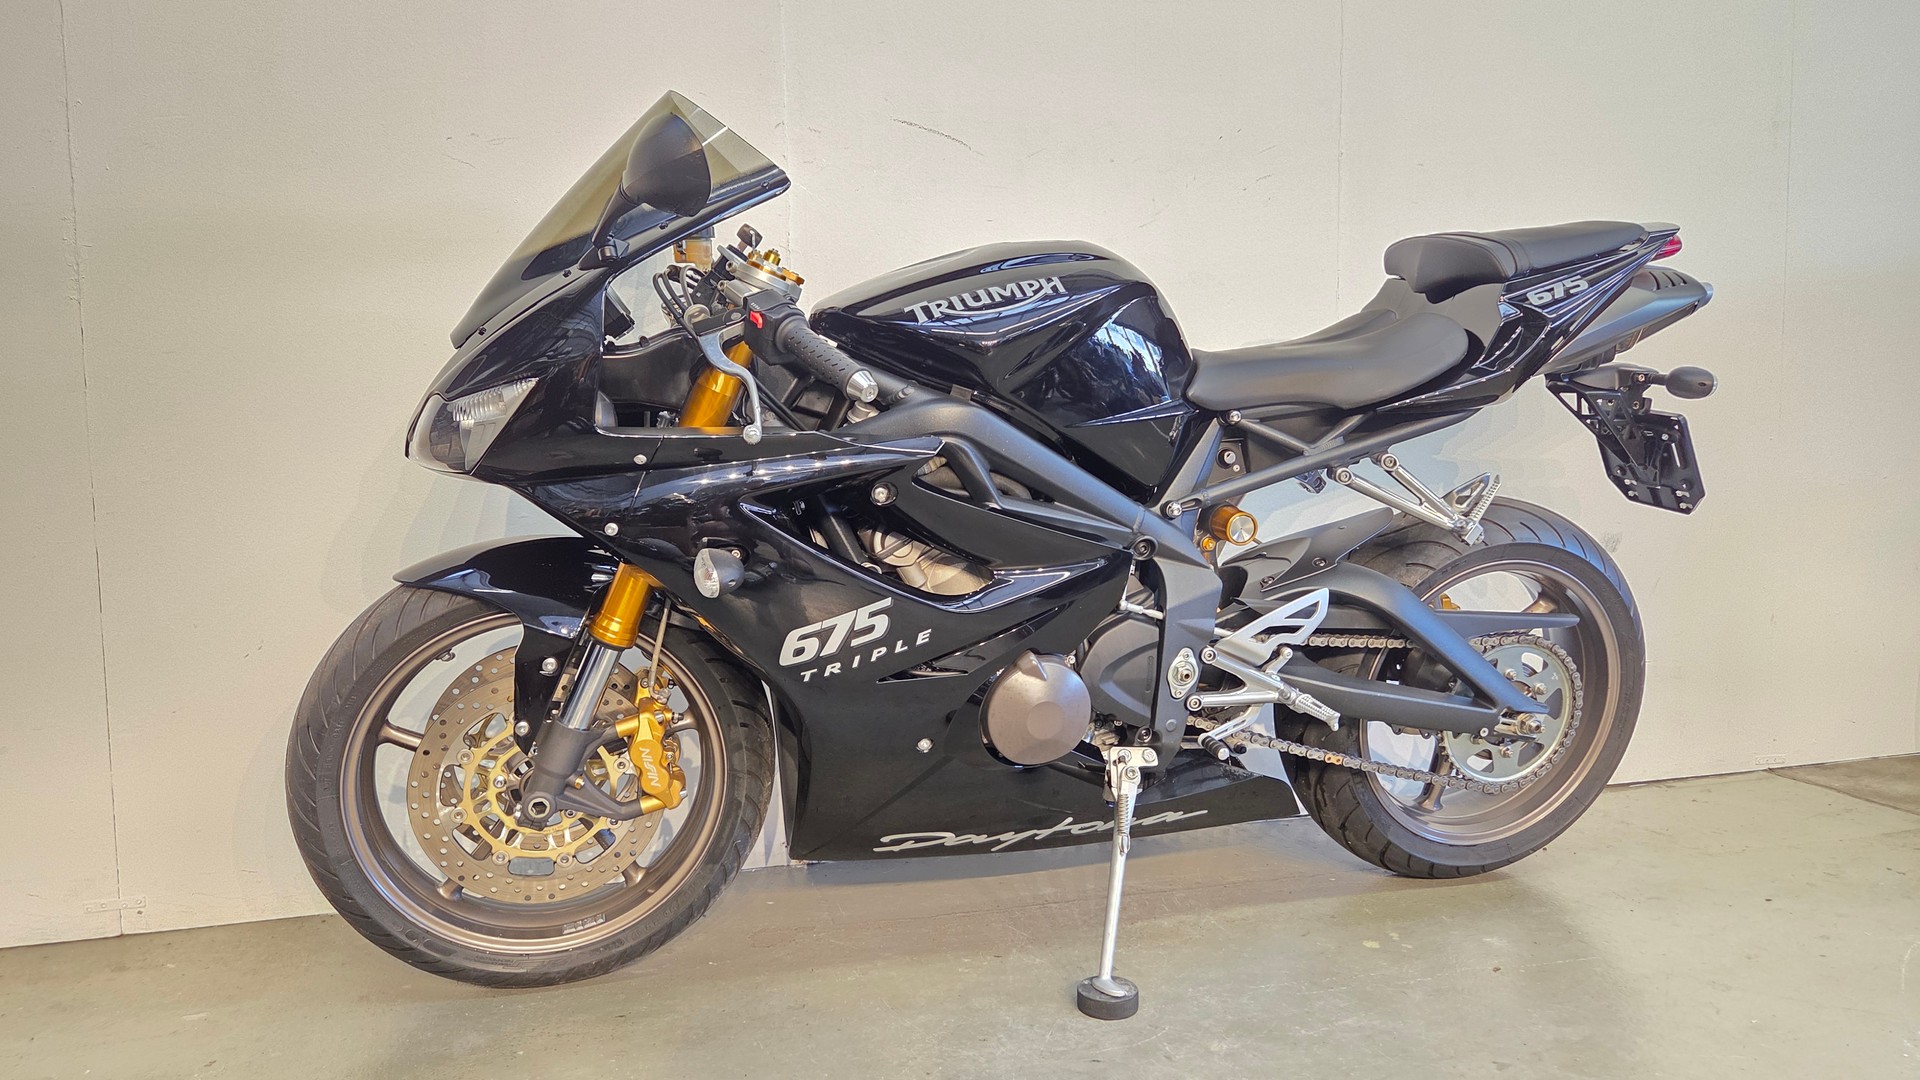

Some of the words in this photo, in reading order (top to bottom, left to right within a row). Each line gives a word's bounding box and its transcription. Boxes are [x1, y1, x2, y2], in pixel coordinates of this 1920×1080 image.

[903, 276, 1068, 325] TRIUMPH
[1526, 275, 1589, 306] 675
[779, 596, 893, 667] 675
[800, 628, 932, 682] TRIPLE
